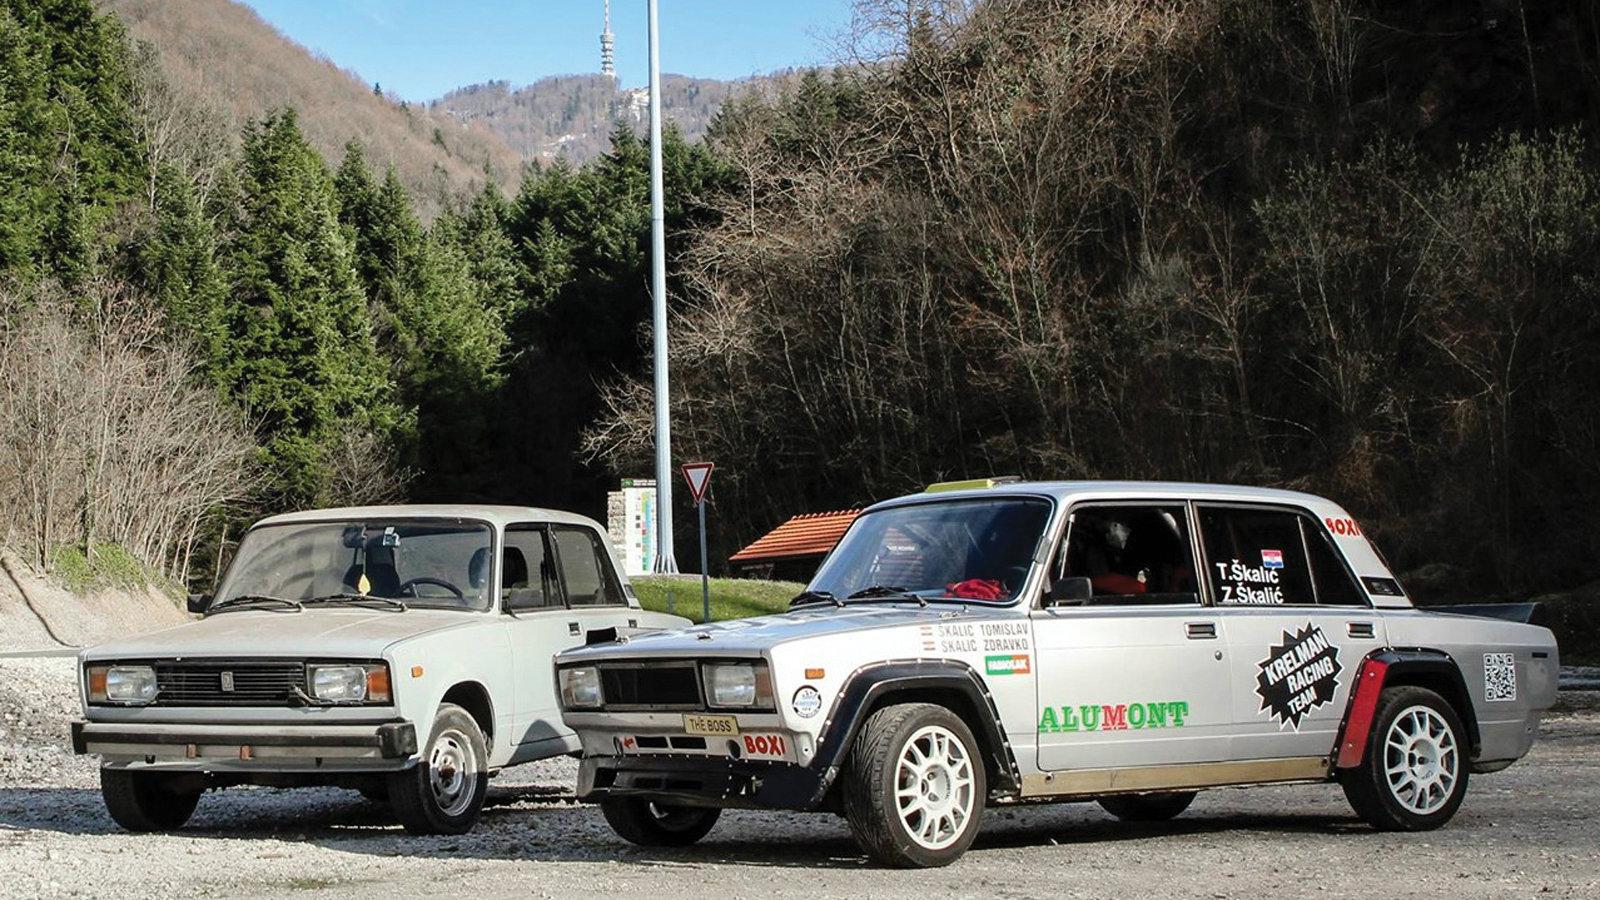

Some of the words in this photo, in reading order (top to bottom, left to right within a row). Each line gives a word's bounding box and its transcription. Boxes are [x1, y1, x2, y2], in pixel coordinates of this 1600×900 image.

[1215, 559, 1279, 584] T.Škalić
[1221, 582, 1284, 604] Z.Škalić
[980, 623, 1028, 636] TOMISLAV
[983, 638, 1029, 651] ZDRAVKO
[1264, 630, 1329, 686] KRELMAN
[1286, 656, 1335, 694] RACING
[1287, 686, 1318, 715] TEAM
[689, 718, 706, 732] THE
[707, 719, 732, 732] BOSS
[1038, 701, 1189, 732] ALUMONT
[743, 735, 786, 756] BOXI
